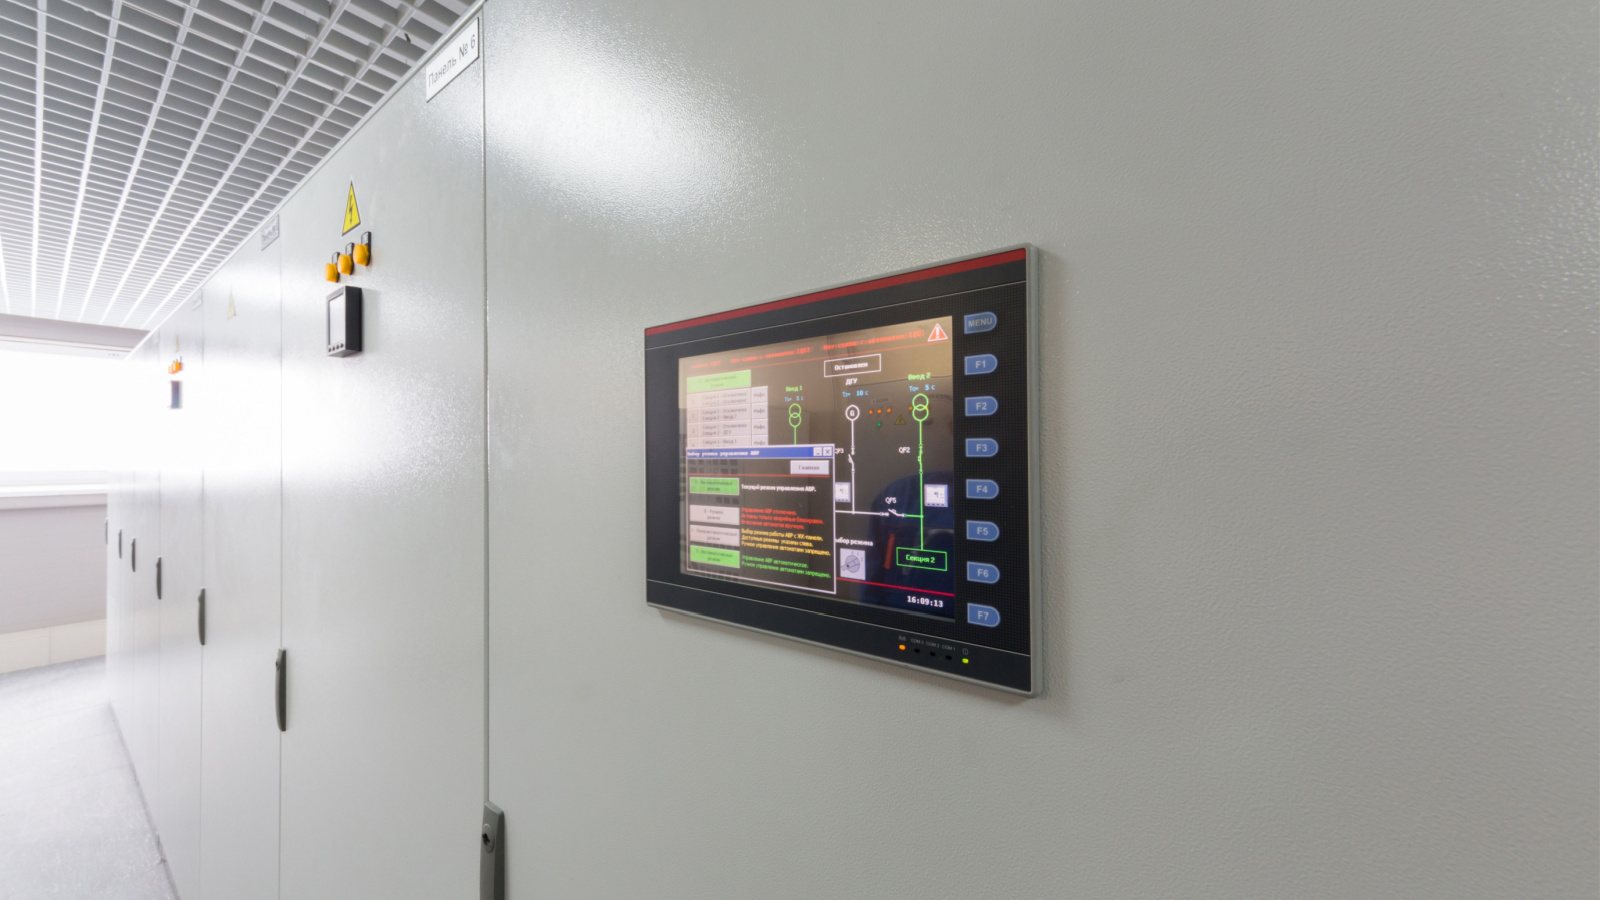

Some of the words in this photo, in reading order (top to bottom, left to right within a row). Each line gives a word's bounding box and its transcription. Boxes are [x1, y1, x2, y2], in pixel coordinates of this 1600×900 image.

[428, 57, 456, 88] Панель
[459, 42, 468, 60] №
[470, 34, 476, 49] 6
[968, 318, 993, 328] MENU
[834, 362, 868, 371] Остановлен
[975, 360, 986, 369] F1
[845, 378, 858, 386] ДГУ
[976, 402, 987, 411] F2
[976, 444, 988, 452] F3
[976, 485, 988, 494] F4
[977, 527, 988, 536] F5
[835, 537, 850, 545] ыбор
[906, 554, 930, 564] Секция
[977, 568, 988, 578] F6
[907, 595, 943, 608] 16:09:13
[977, 610, 989, 620] F7
